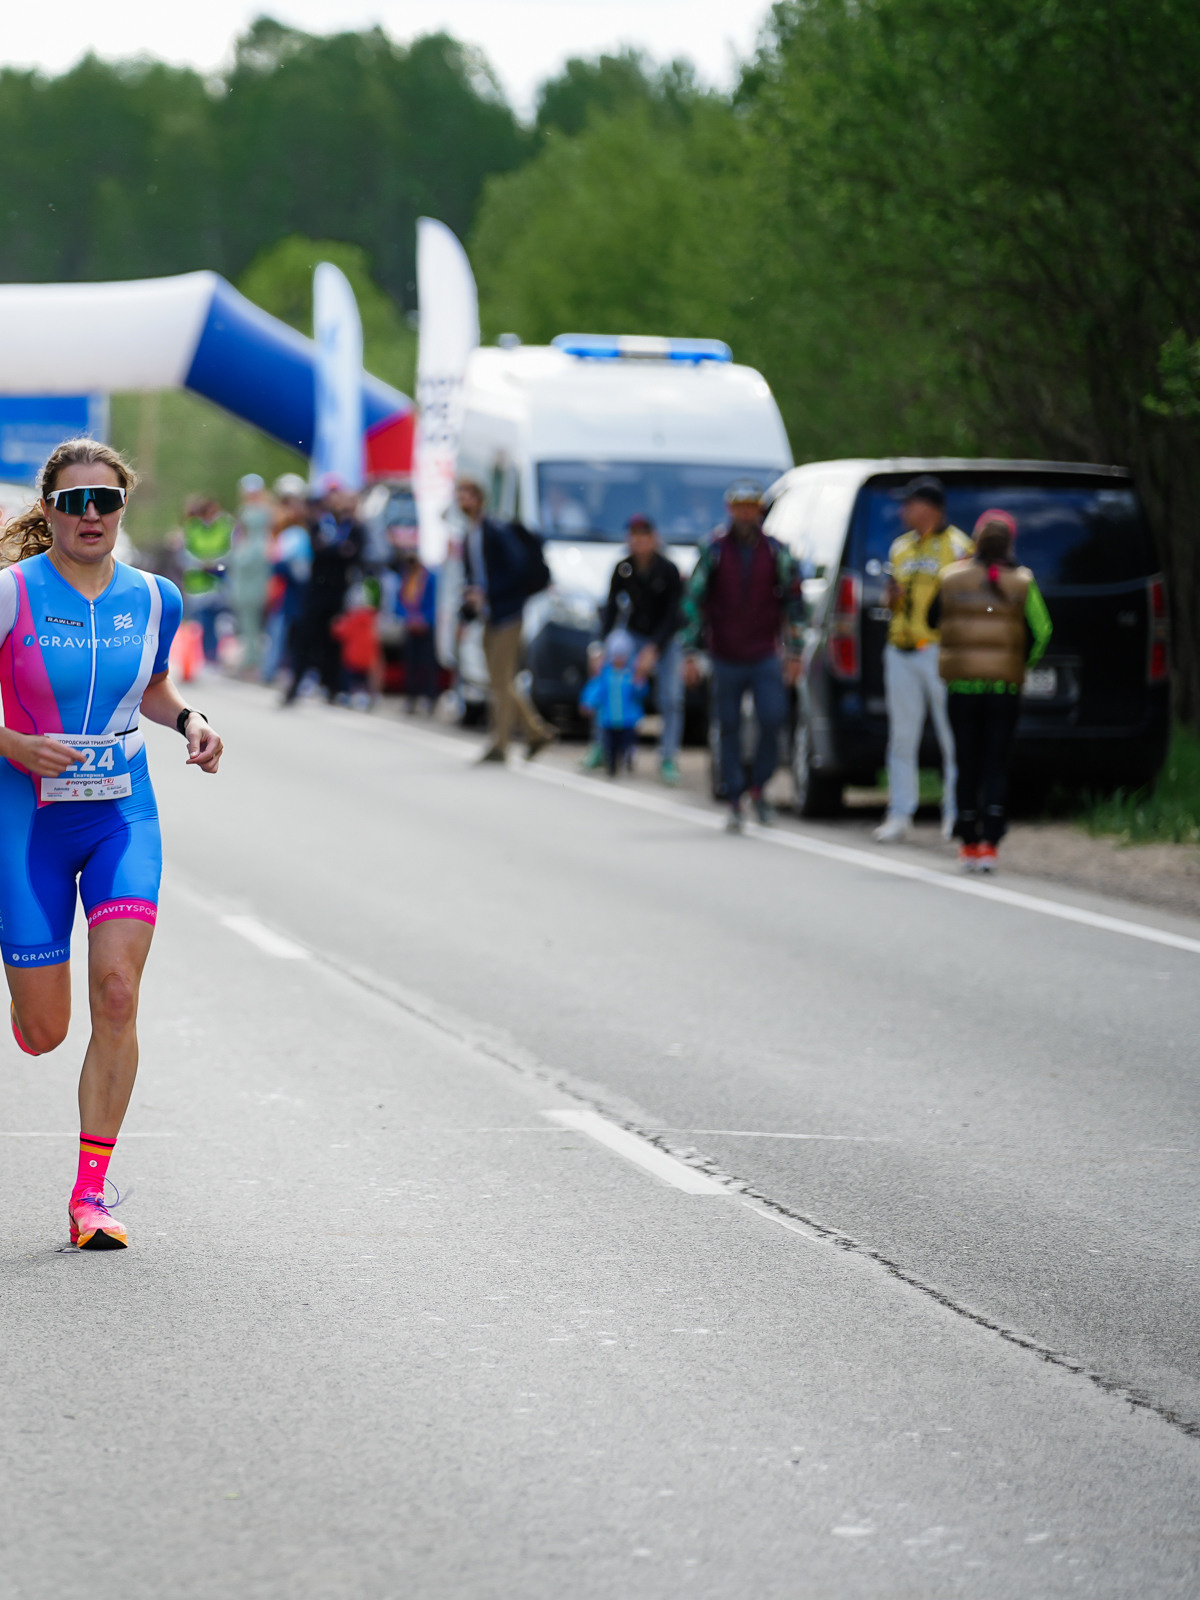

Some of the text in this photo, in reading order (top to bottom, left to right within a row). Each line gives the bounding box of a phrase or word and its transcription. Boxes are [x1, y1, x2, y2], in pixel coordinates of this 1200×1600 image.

[38, 634, 155, 649] GRAVITYSPORT
[66, 747, 115, 771] 24
[92, 904, 156, 920] GRAVITYSPOR
